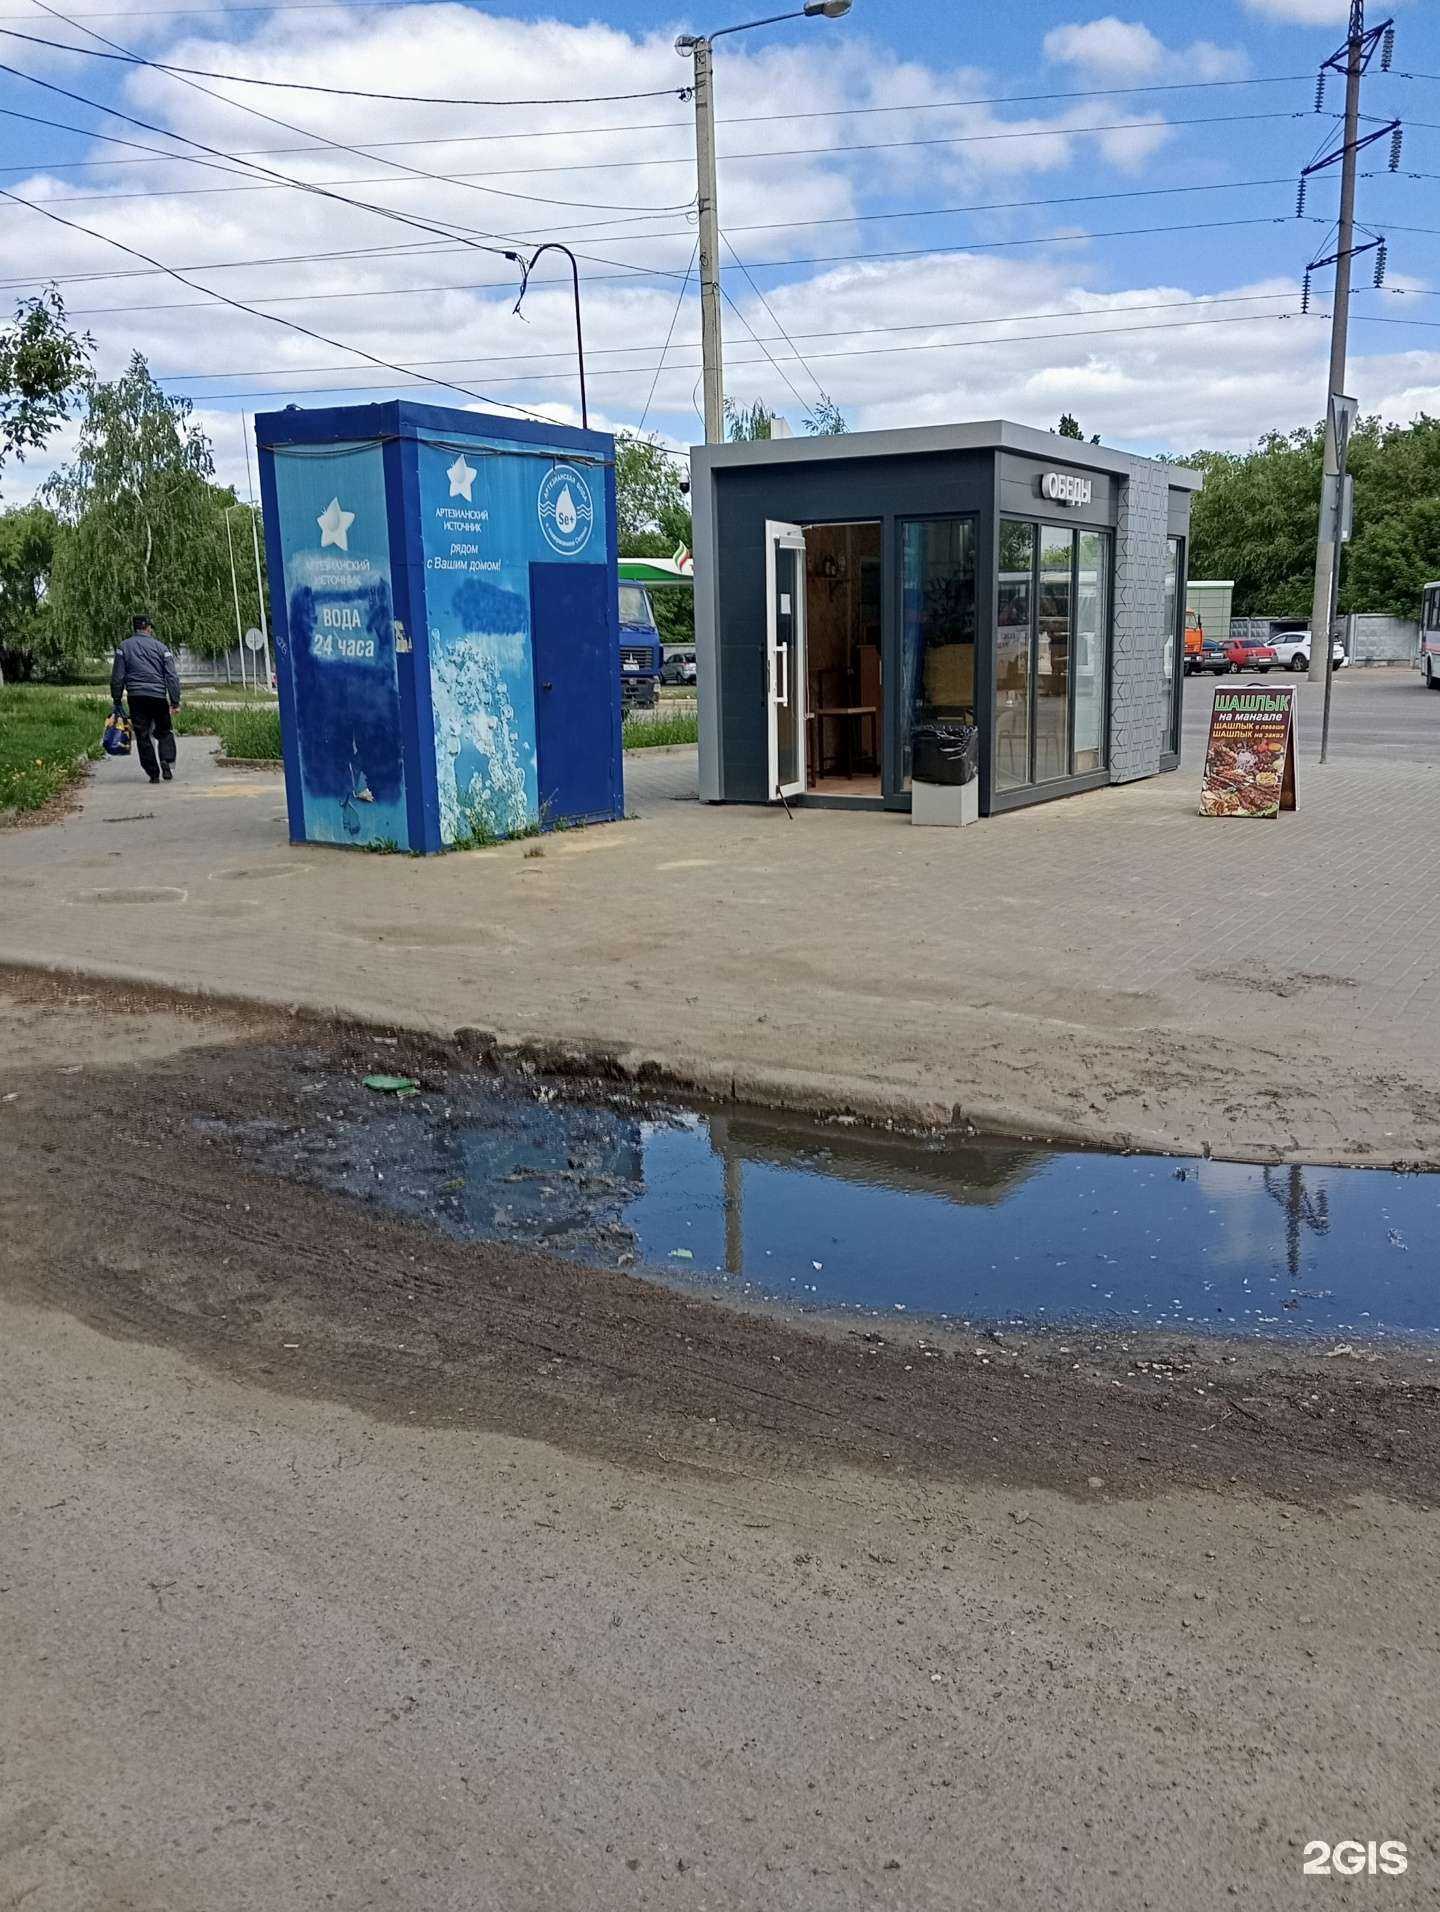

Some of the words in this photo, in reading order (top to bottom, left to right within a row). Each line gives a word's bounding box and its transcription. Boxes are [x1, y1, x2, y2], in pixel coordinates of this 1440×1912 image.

[1043, 472, 1092, 507] ОБЕДЫ
[435, 507, 489, 520] АРТЕЗИАНСКИЙ
[558, 512, 575, 526] Se+
[443, 520, 482, 532] ИСТОЧНИК
[450, 543, 479, 556] рядом
[426, 559, 433, 569] с
[434, 556, 468, 570] Вашим
[469, 558, 502, 573] домом!
[322, 608, 362, 631] ВОДА
[313, 633, 333, 655] 24
[337, 638, 375, 657] часа
[1214, 694, 1291, 712] ШАШЛЫК
[1218, 713, 1233, 721] на
[1234, 713, 1283, 721] мангале
[1213, 722, 1255, 730] ШАШЛЫК
[1212, 730, 1253, 738] ШАШЛЫК
